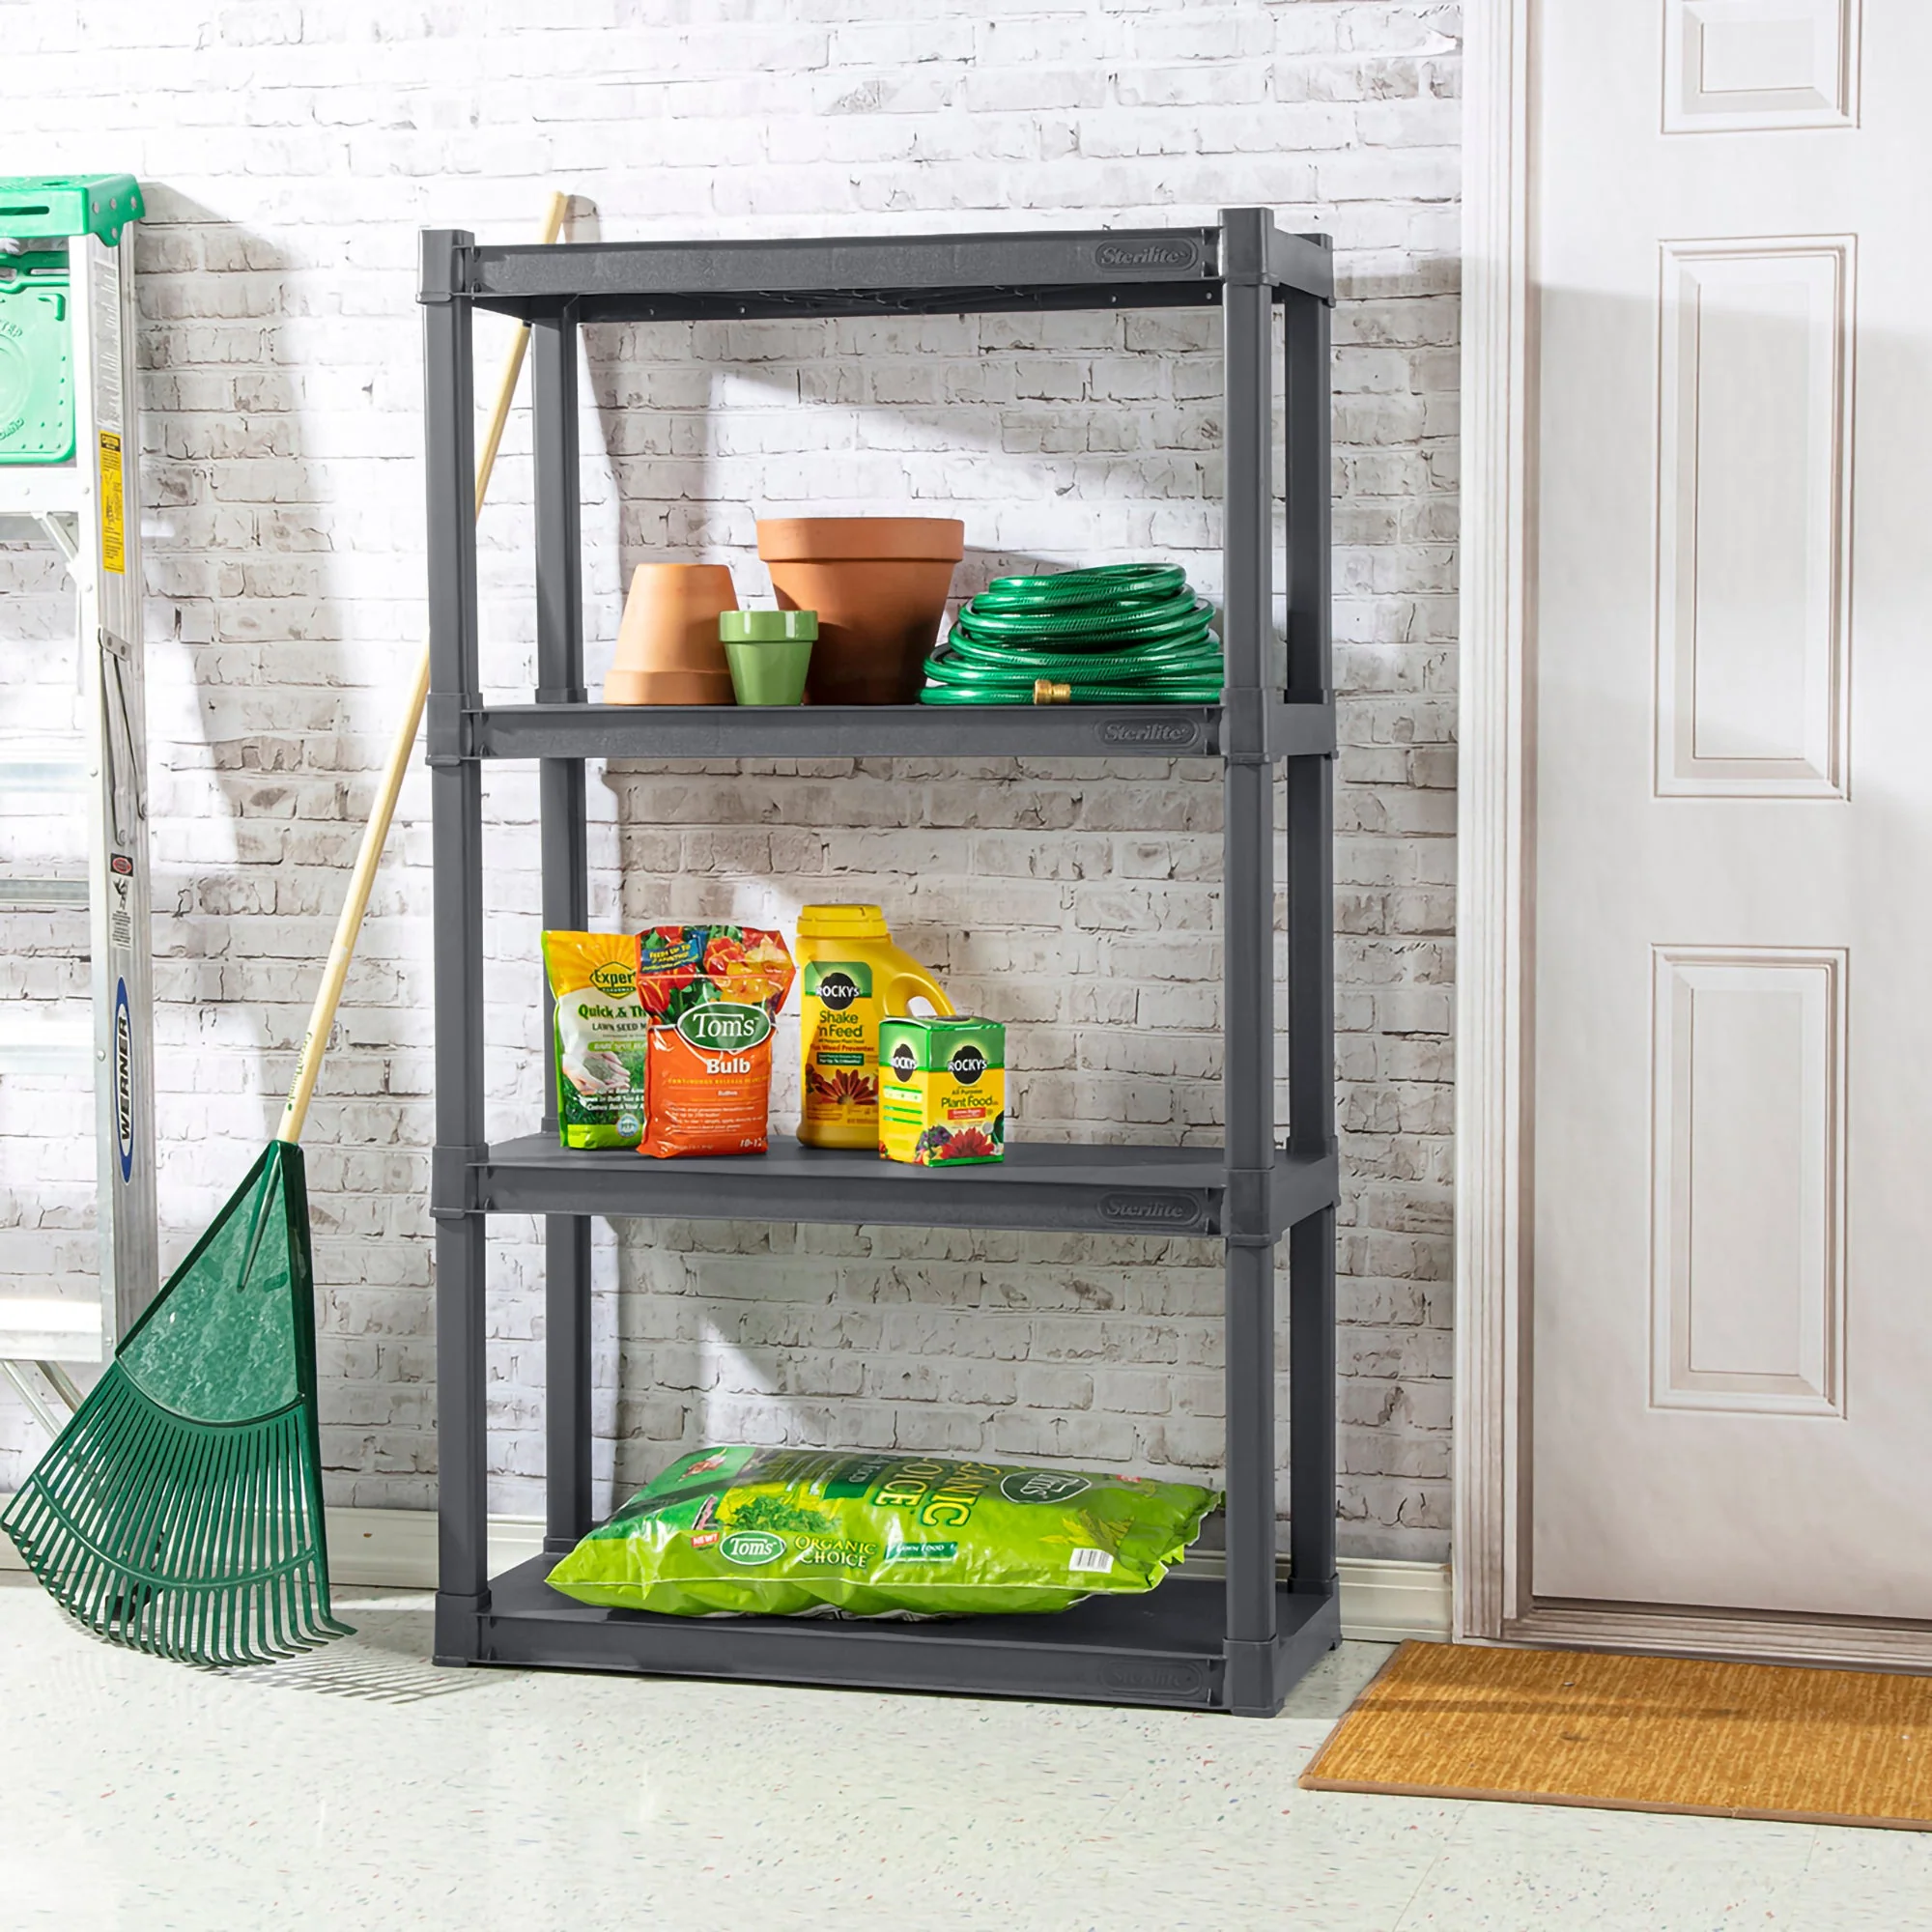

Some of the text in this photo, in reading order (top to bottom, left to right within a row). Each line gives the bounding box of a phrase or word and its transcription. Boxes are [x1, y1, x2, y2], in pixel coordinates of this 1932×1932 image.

[1100, 245, 1180, 265] Sterilite
[1104, 723, 1182, 742] Sterilite
[578, 1004, 613, 1020] Quick
[615, 1007, 627, 1018] &
[820, 1010, 859, 1024] Shake
[616, 1023, 639, 1032] SEED
[829, 1024, 864, 1037] Feed
[706, 1058, 751, 1074] Bulb
[117, 1015, 130, 1141] WERNER
[941, 1094, 993, 1108] Plant Food
[1106, 1198, 1184, 1218] Sterilite
[875, 1462, 943, 1507] OICE
[921, 1460, 1004, 1526] GANIC
[794, 1535, 876, 1555] ORGANIC
[800, 1549, 867, 1568] CHOICE
